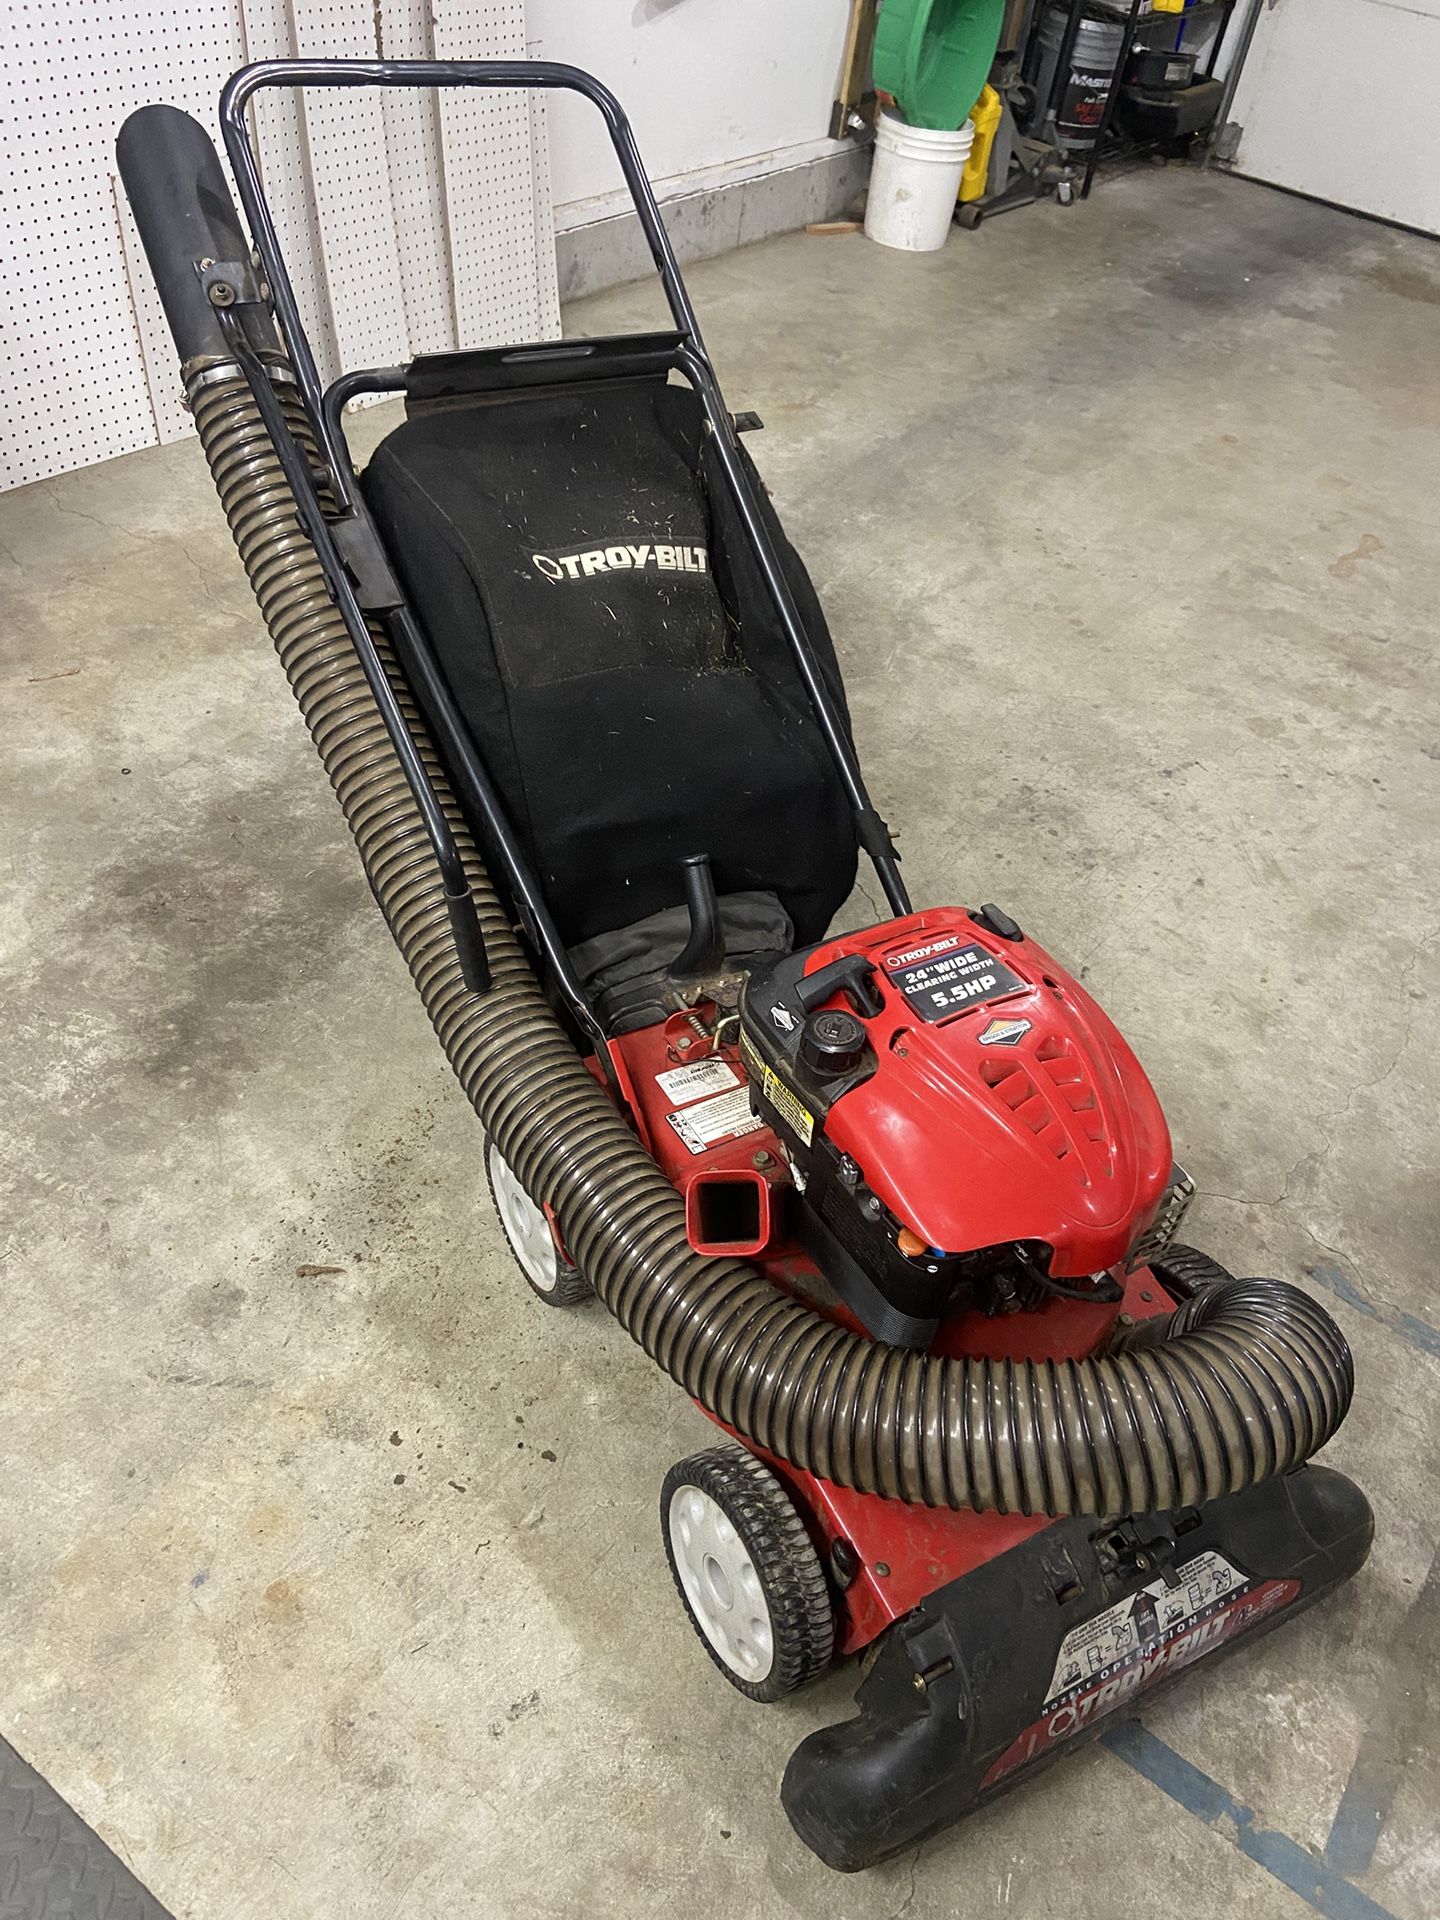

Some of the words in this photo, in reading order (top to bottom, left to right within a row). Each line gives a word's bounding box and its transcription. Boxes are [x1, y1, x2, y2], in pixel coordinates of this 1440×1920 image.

[558, 544, 708, 579] TROY-BILT
[898, 936, 959, 964] TROY-BILT
[904, 972, 958, 994] CLEARING
[960, 958, 994, 976] WIDTH
[930, 974, 997, 1008] 5.5HP
[777, 1079, 806, 1116] WARNING
[733, 1121, 765, 1138] DANGER
[1099, 1616, 1198, 1681] OPERATION
[1205, 1585, 1249, 1617] HOSE
[1078, 1610, 1232, 1720] TROY-BILT
